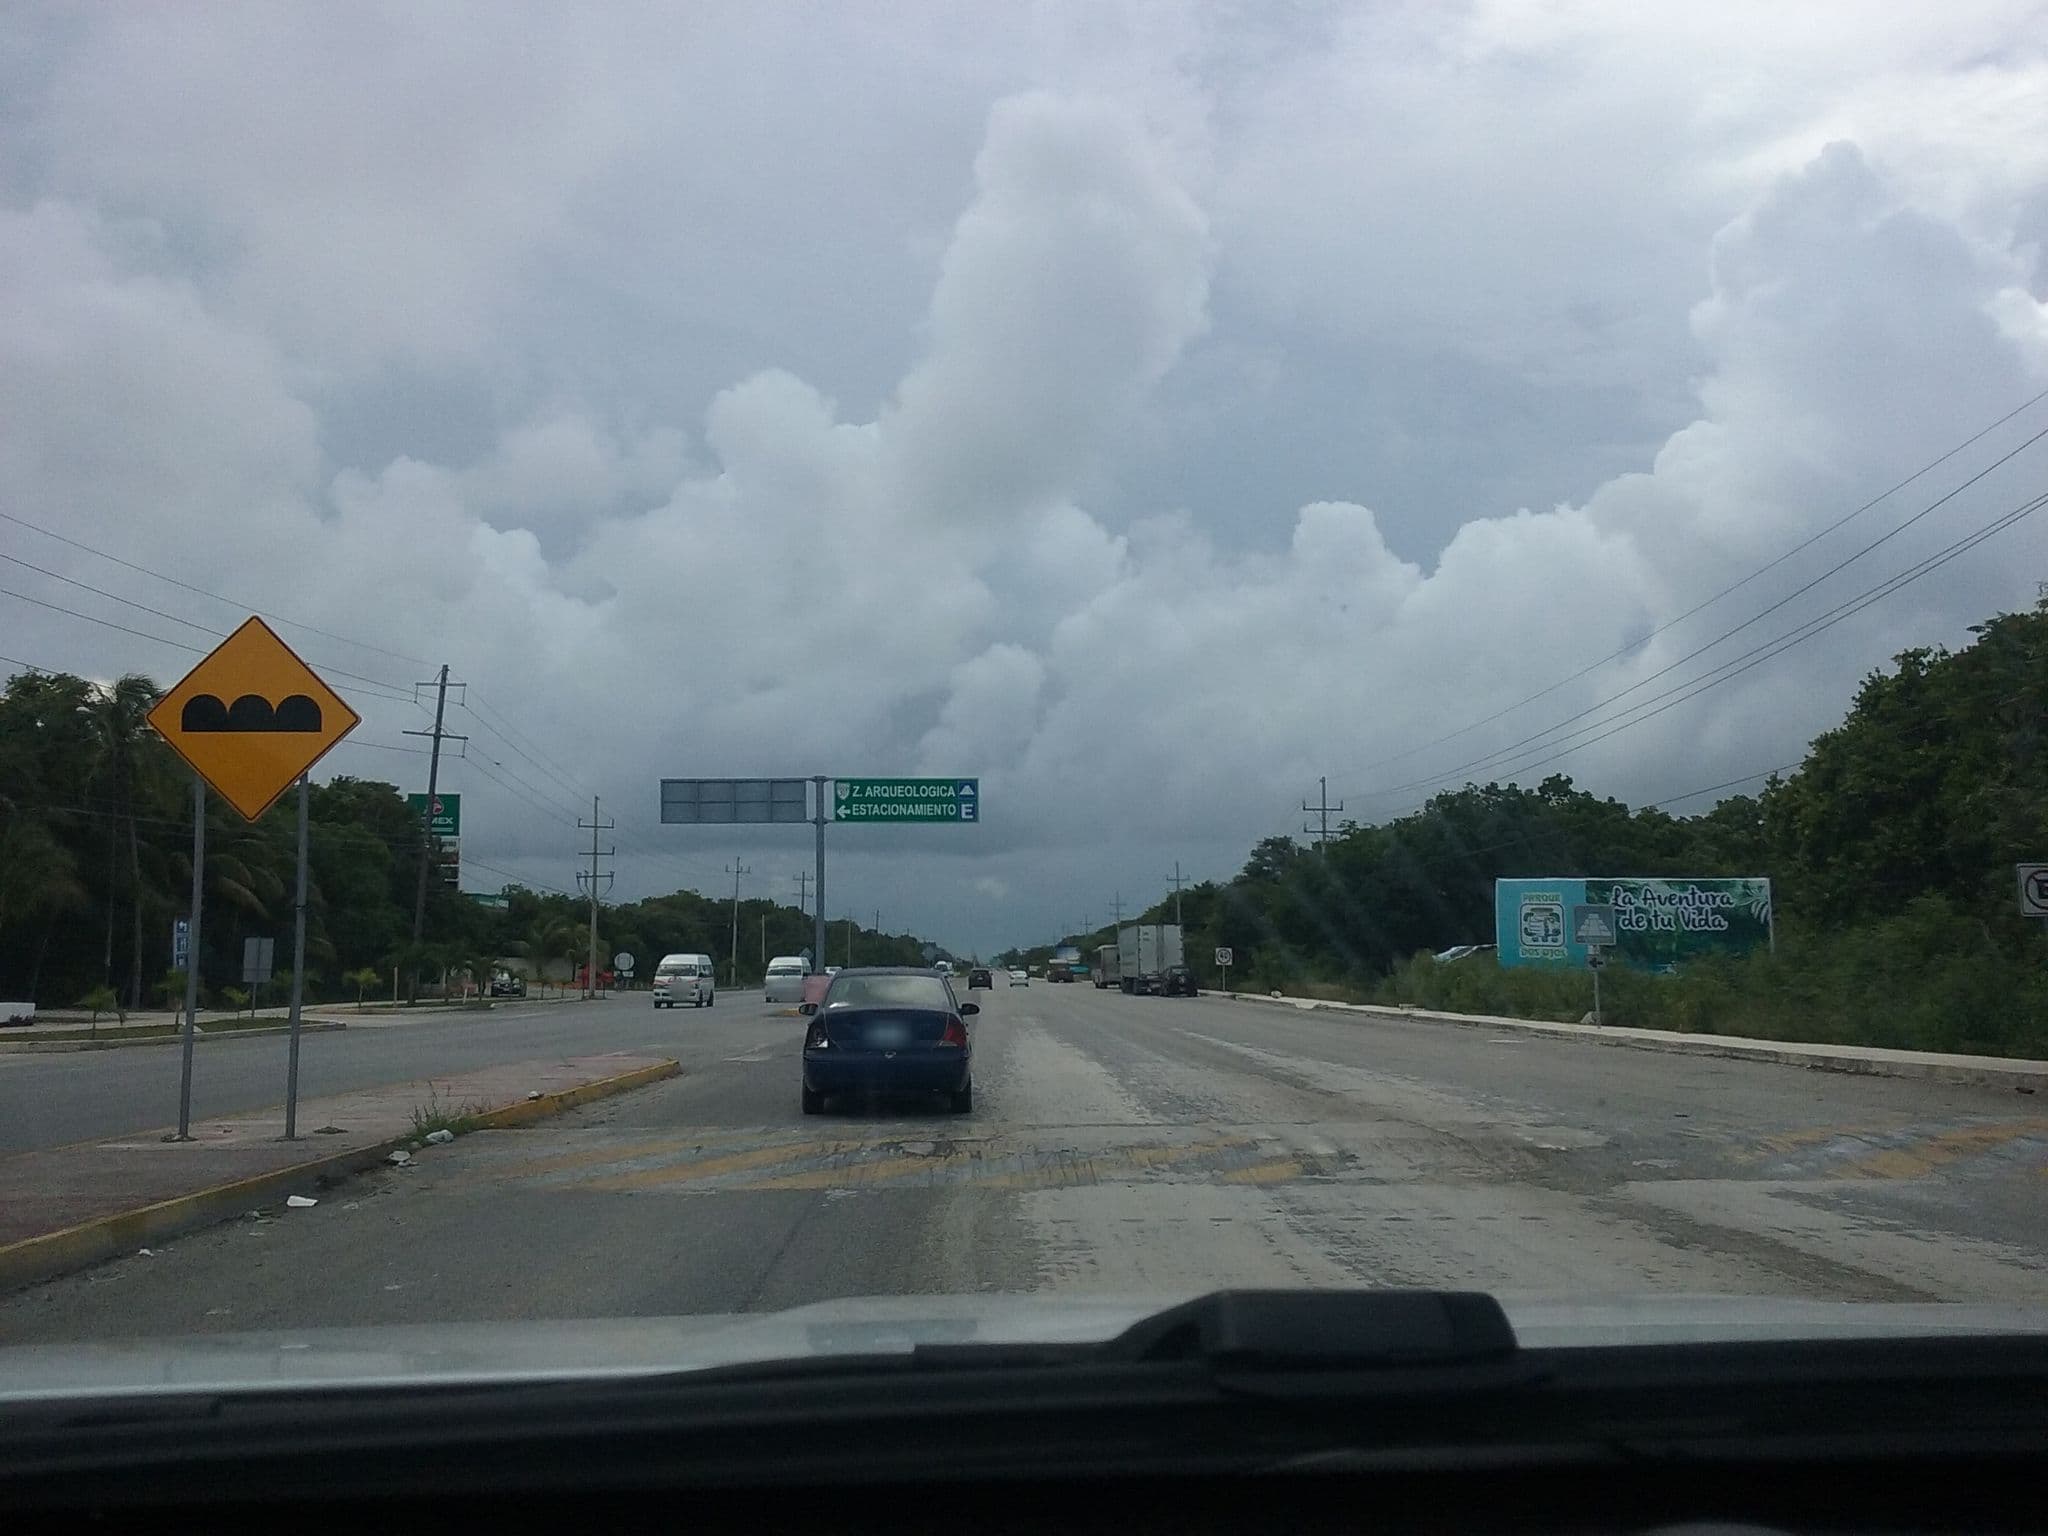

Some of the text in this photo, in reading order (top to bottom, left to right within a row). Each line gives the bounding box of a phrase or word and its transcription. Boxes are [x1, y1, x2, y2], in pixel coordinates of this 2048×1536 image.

[852, 785, 956, 798] Z. ARQUEOLOGICA
[852, 803, 957, 816] ESTACIONAMIENTO
[960, 803, 974, 819] E
[1611, 885, 1735, 908] La Aventura
[1621, 908, 1728, 930] de tu Vida
